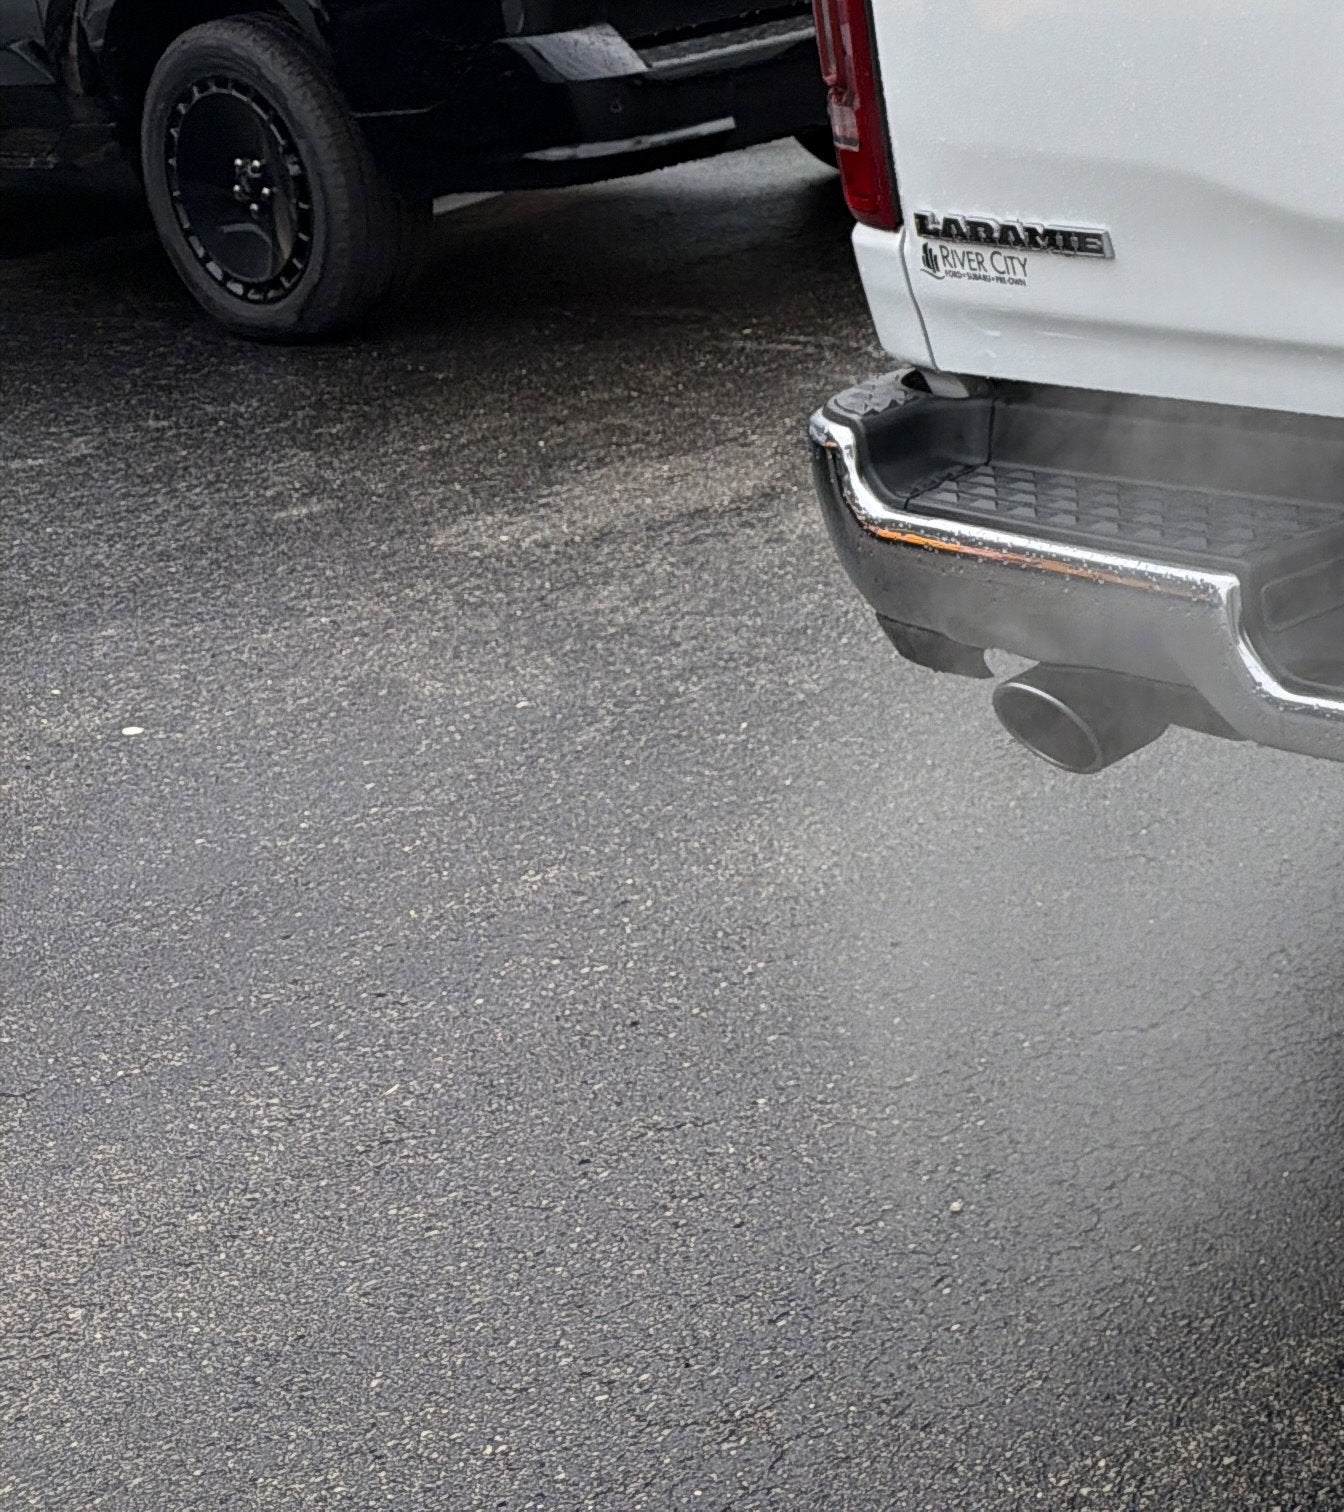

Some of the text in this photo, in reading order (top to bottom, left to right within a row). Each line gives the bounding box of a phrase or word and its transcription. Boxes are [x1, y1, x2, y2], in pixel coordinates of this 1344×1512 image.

[913, 210, 1115, 259] LARAMIE
[938, 244, 1028, 278] RIVER CITY
